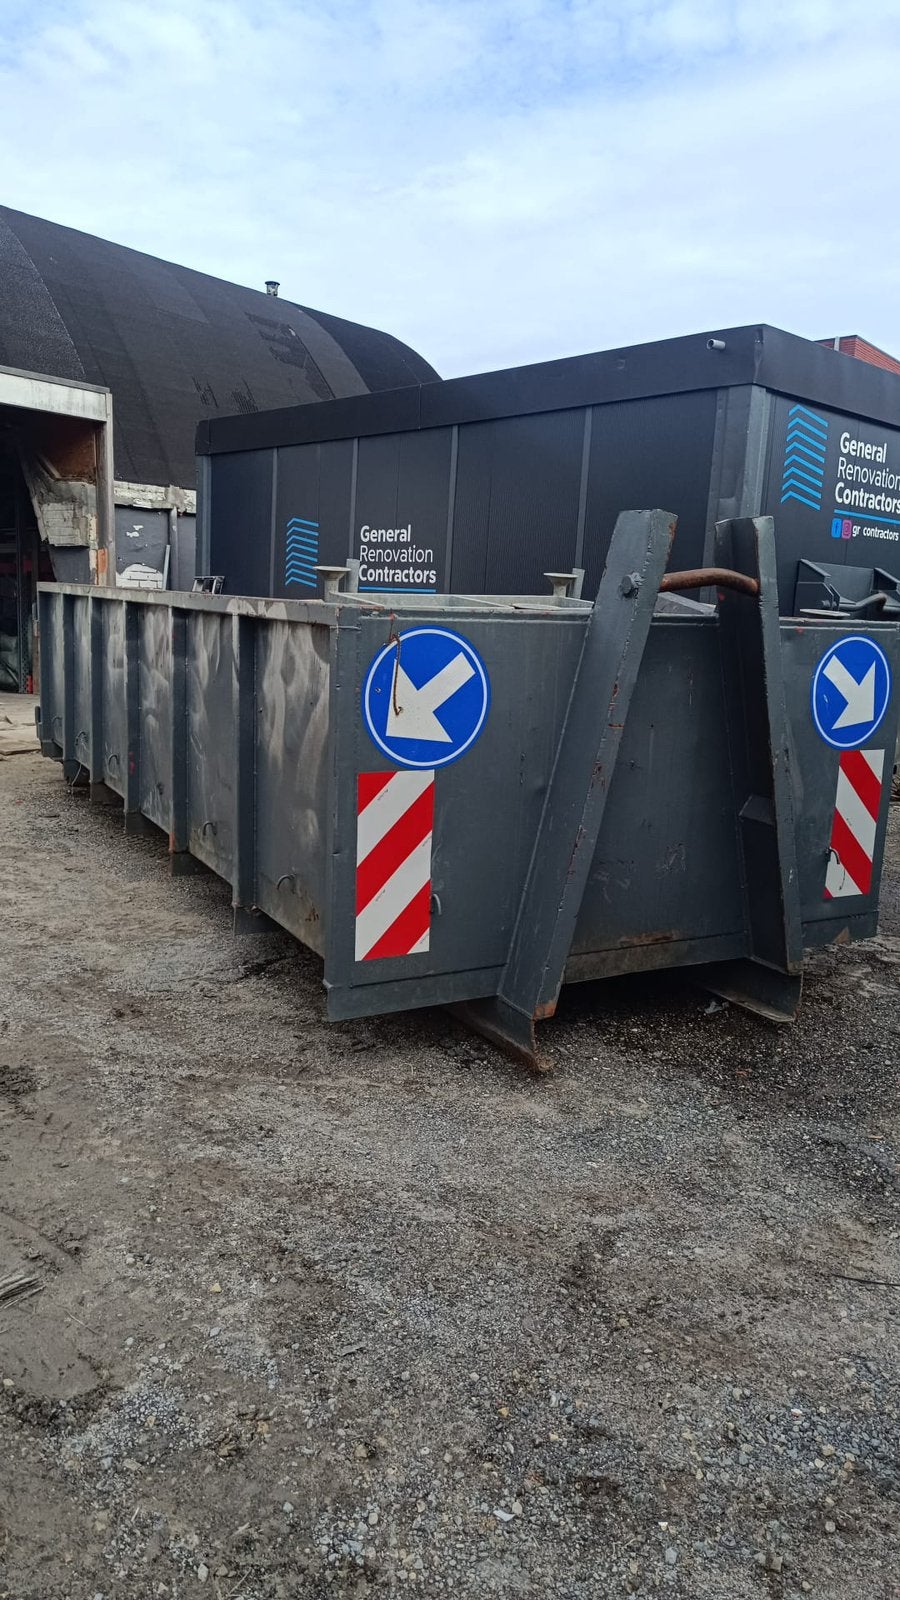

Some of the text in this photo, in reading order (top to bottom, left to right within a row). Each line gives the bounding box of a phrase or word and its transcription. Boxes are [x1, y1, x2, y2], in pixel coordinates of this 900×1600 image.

[840, 432, 887, 463] General
[837, 457, 900, 491] Renovation
[835, 482, 900, 514] Contractors
[360, 524, 411, 542] General
[852, 525, 861, 537] gr
[863, 526, 899, 541] contractors
[360, 544, 433, 562] Renovation
[359, 564, 436, 583] Contractors
